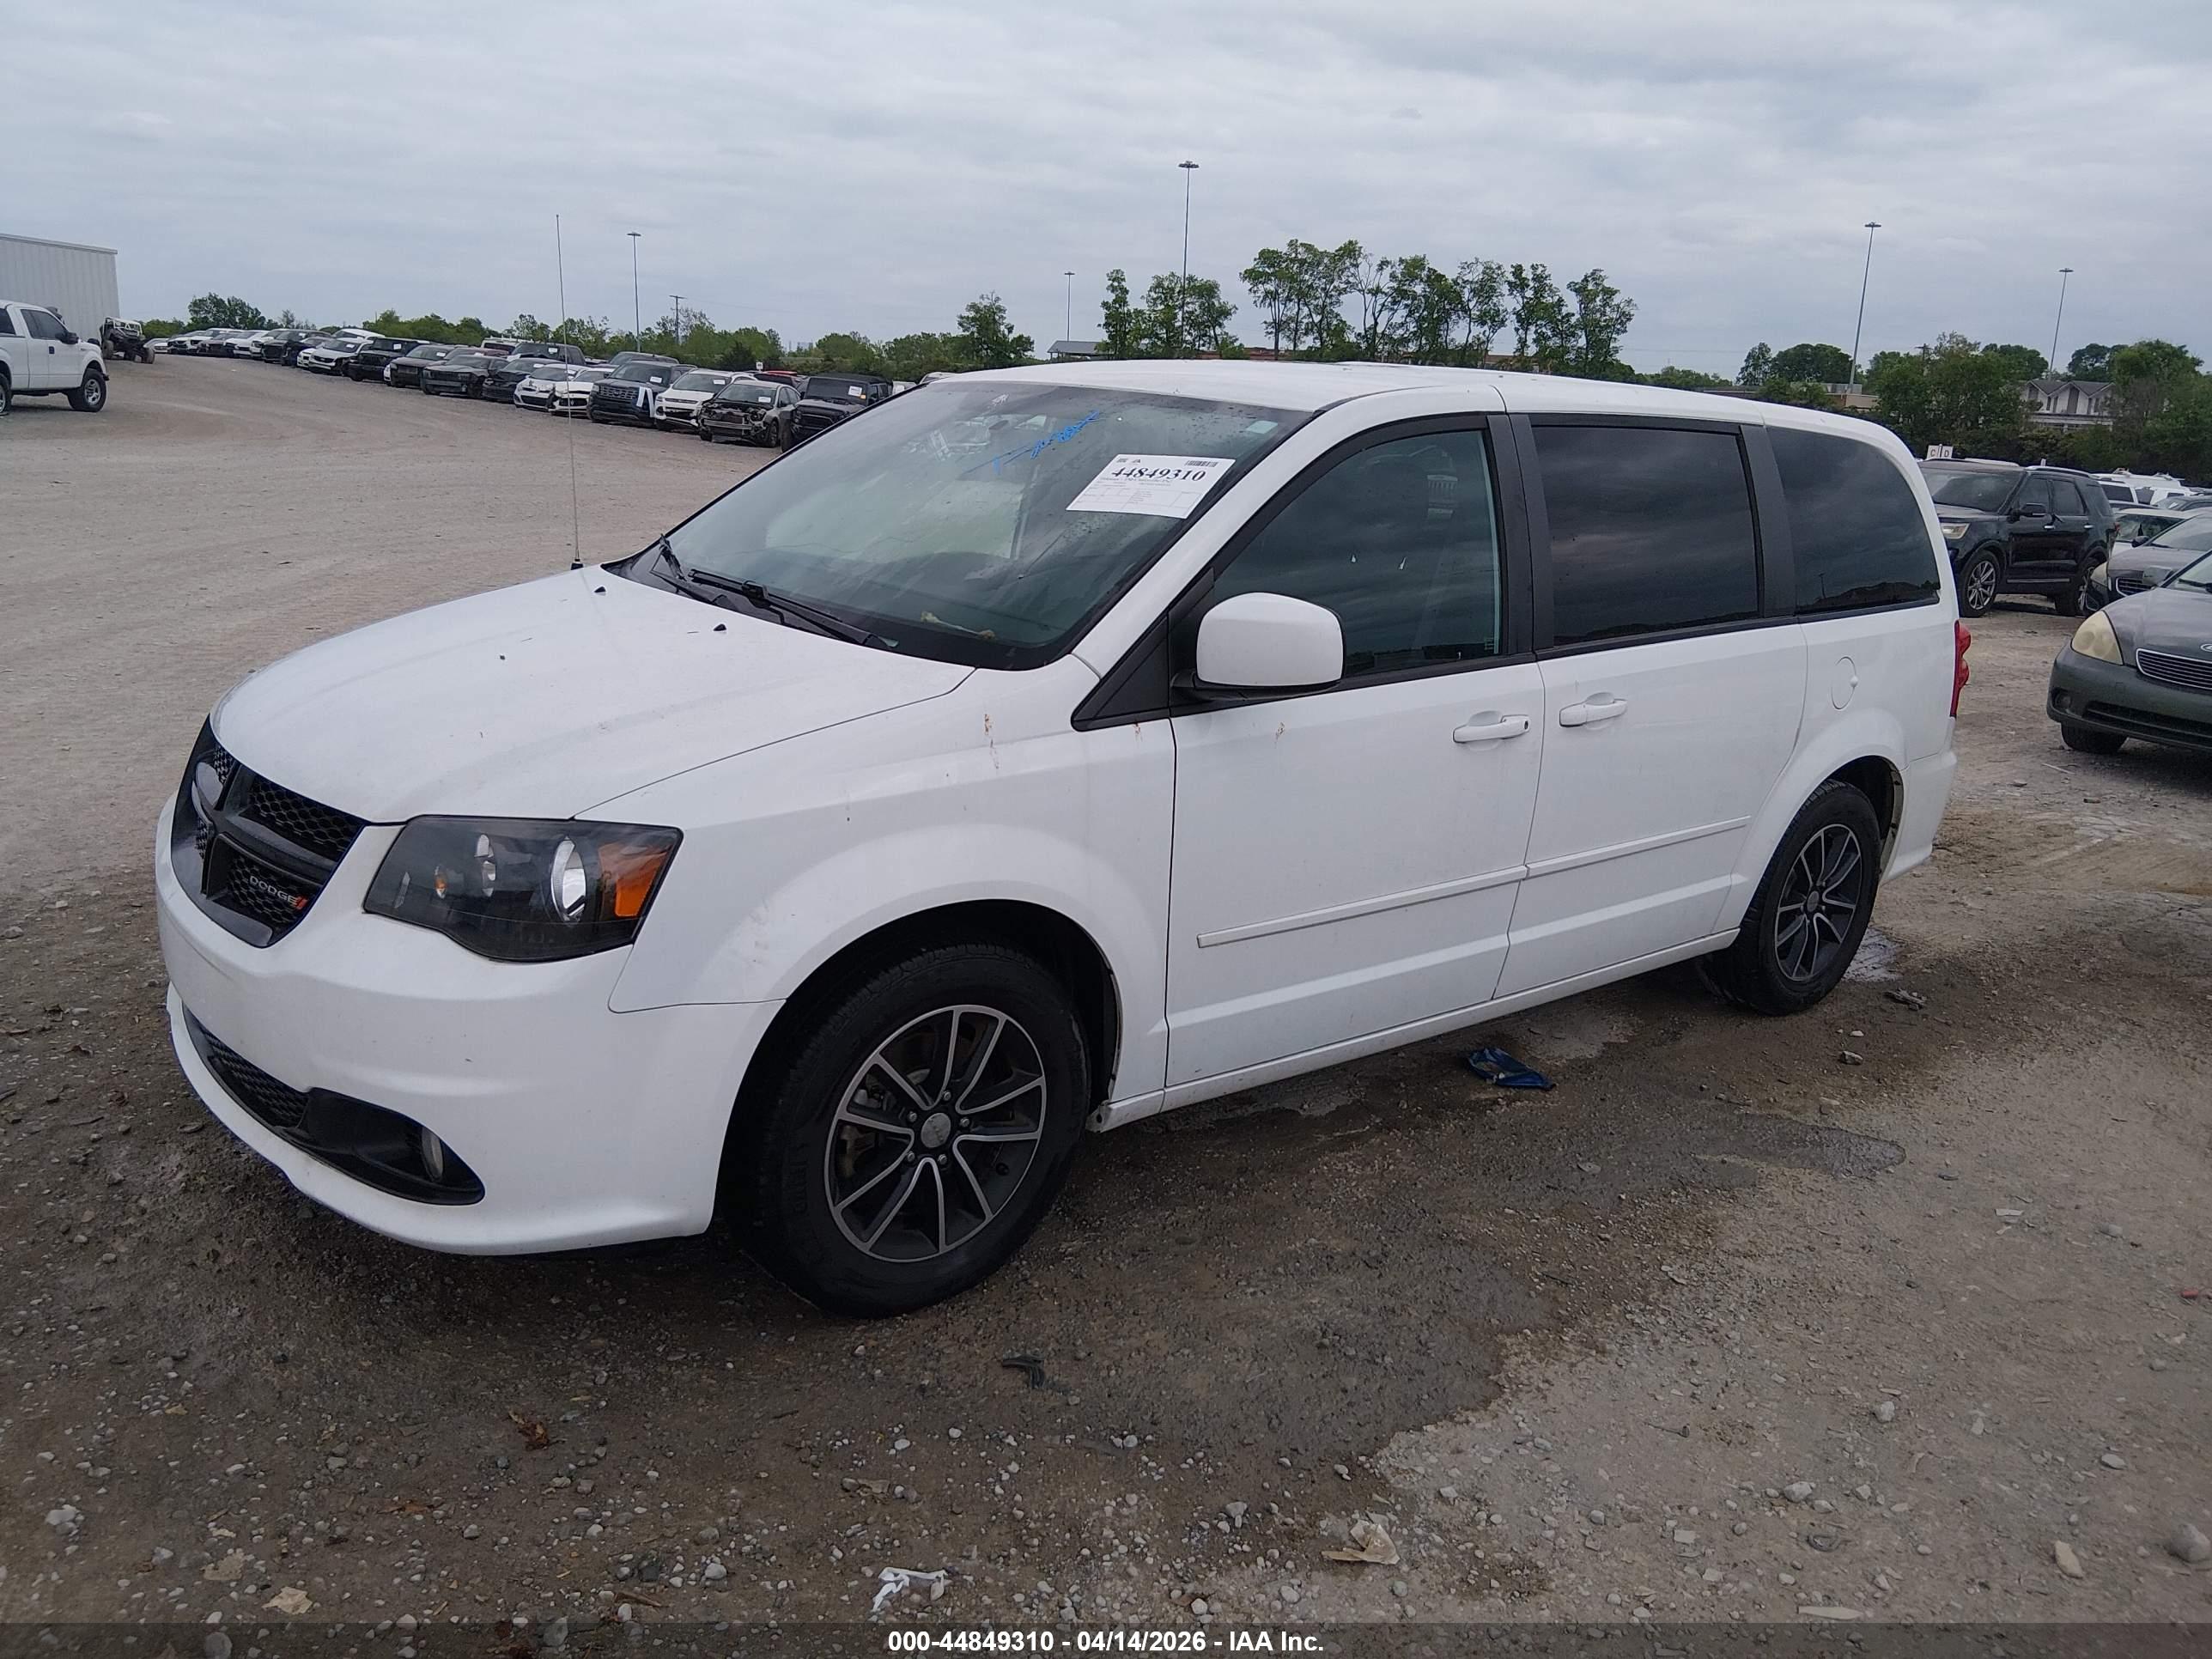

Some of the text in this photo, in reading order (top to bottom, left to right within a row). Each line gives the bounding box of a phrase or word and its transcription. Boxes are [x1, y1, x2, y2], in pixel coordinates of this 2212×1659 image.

[1930, 449, 1936, 458] C
[1943, 449, 1950, 458] D
[1111, 466, 1207, 483] 44849310
[249, 875, 299, 908] DODGE
